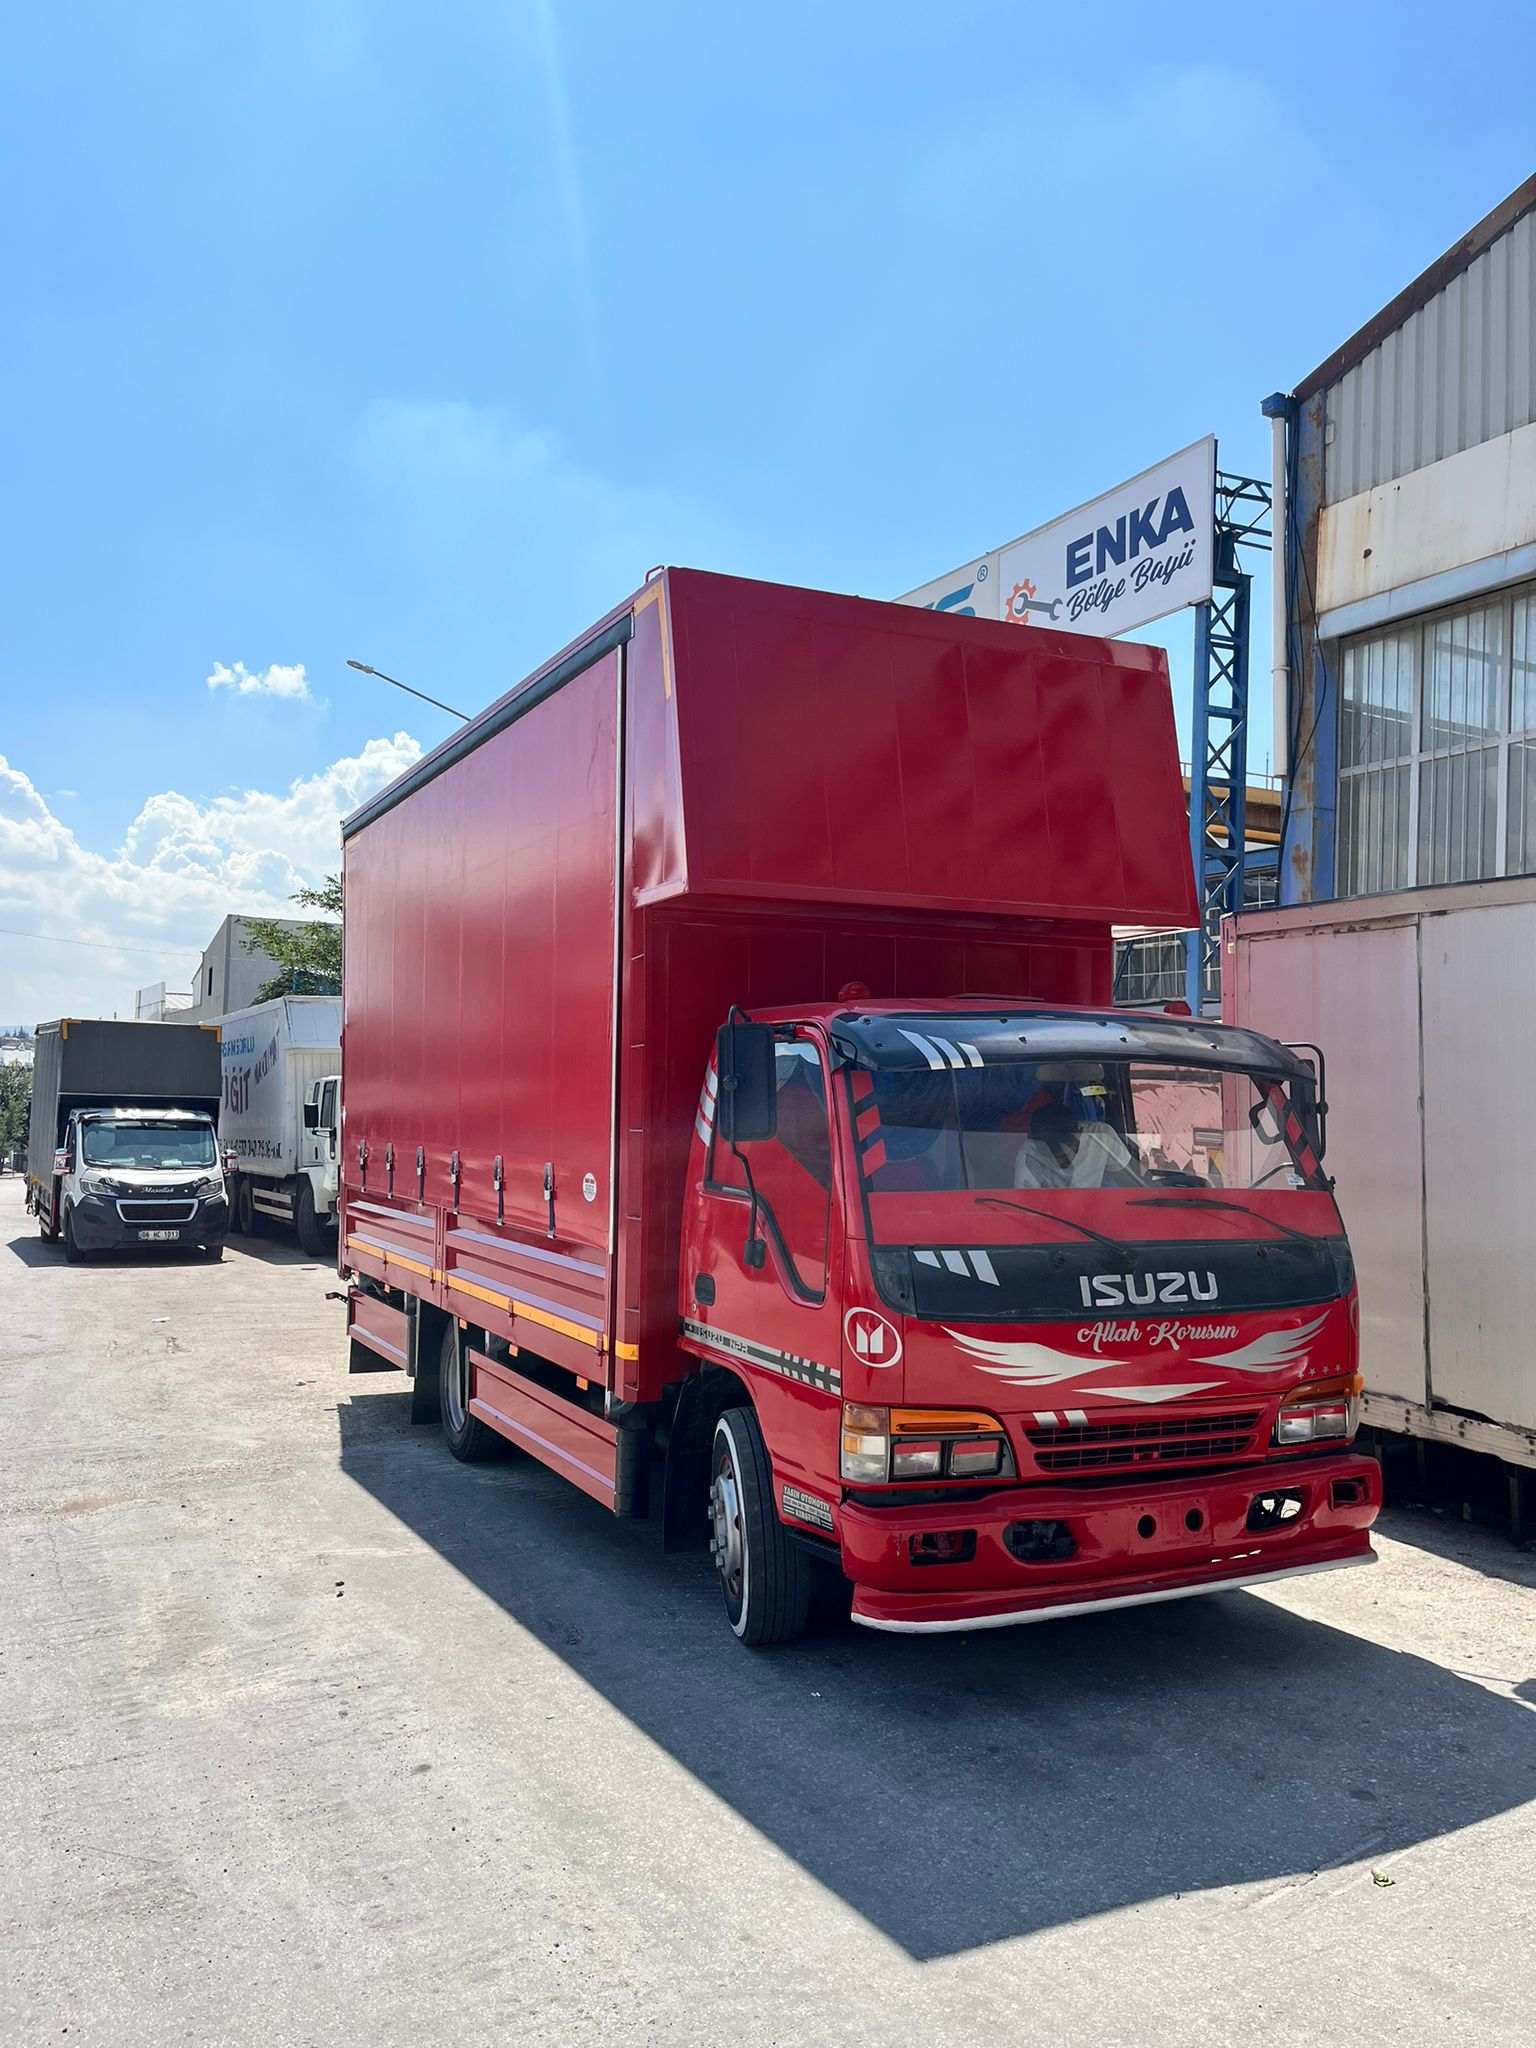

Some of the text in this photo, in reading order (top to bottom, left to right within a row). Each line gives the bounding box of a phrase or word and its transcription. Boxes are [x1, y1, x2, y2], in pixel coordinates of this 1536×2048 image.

[1066, 486, 1195, 590] ENKA
[1066, 578, 1126, 622] Bölge
[1079, 1271, 1219, 1308] ISUZU
[1077, 1321, 1239, 1353] Allah Korusun
